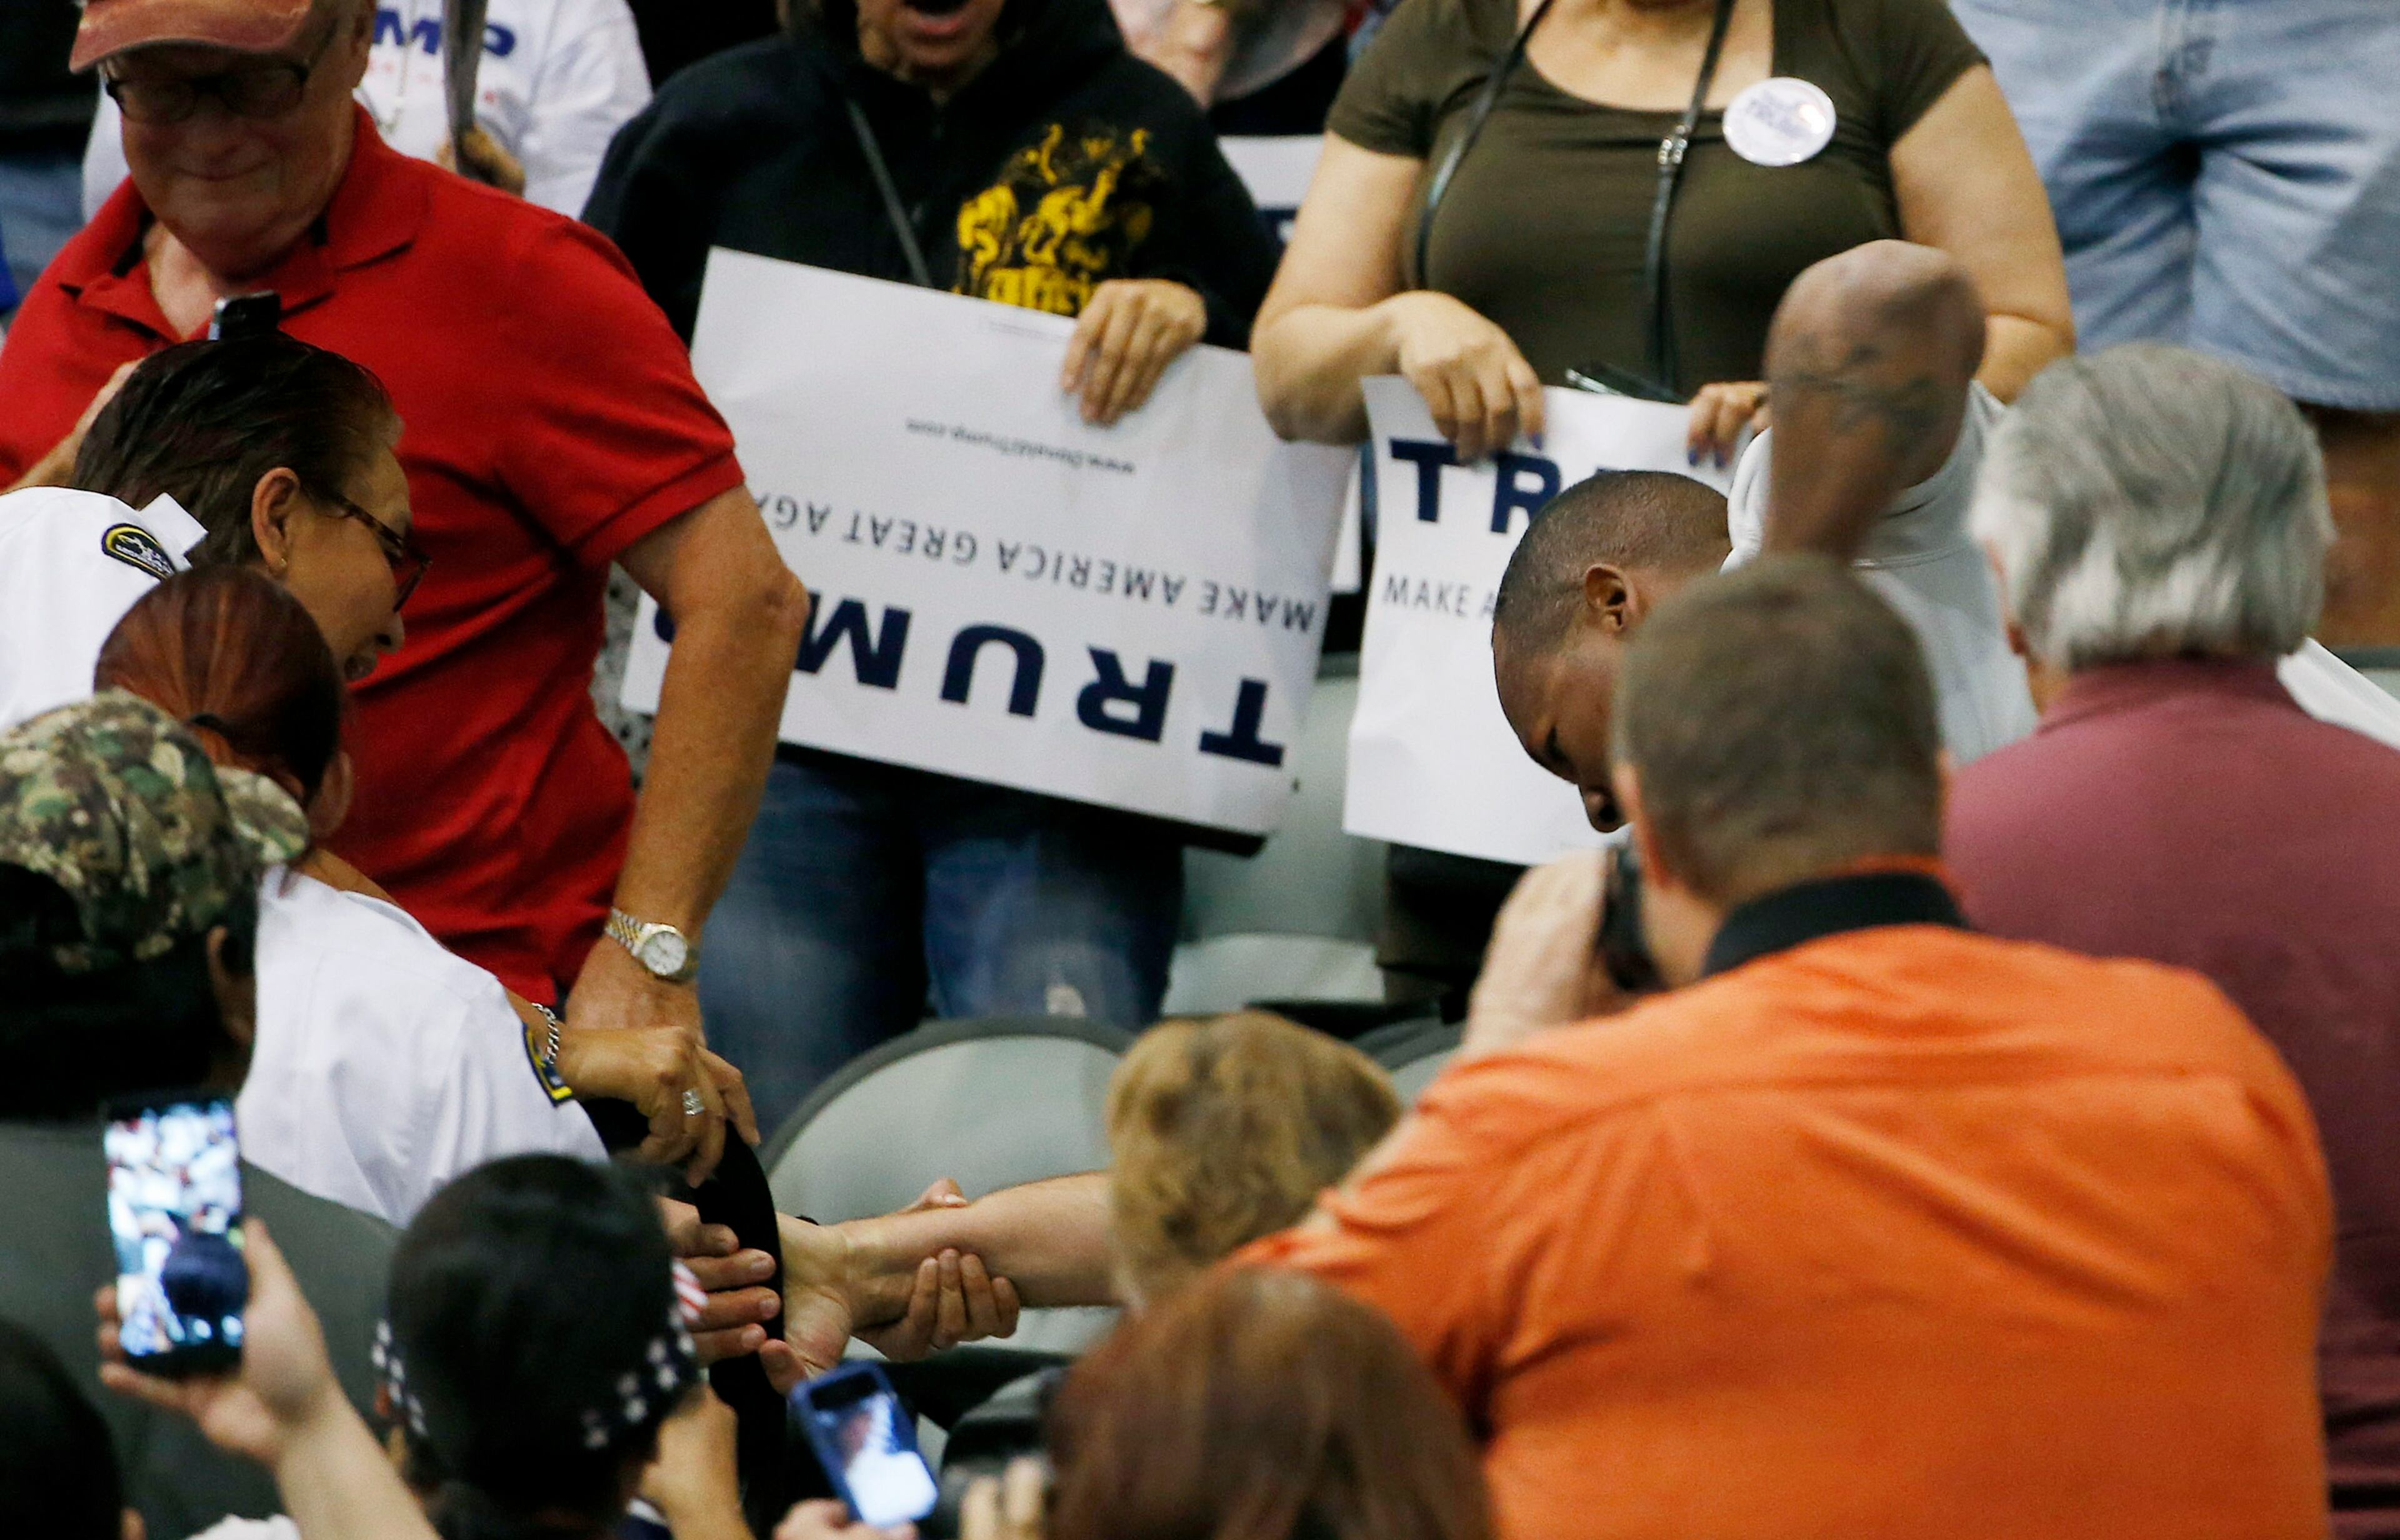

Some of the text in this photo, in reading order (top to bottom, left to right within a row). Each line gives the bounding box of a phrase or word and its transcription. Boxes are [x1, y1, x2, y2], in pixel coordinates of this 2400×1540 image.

[1389, 436, 1625, 534] TR
[843, 512, 978, 566] GREAT
[998, 539, 1185, 606] AMERICA
[1382, 572, 1471, 618] MAKE
[1198, 579, 1316, 632] MAKE
[654, 589, 1286, 768] TRUM
